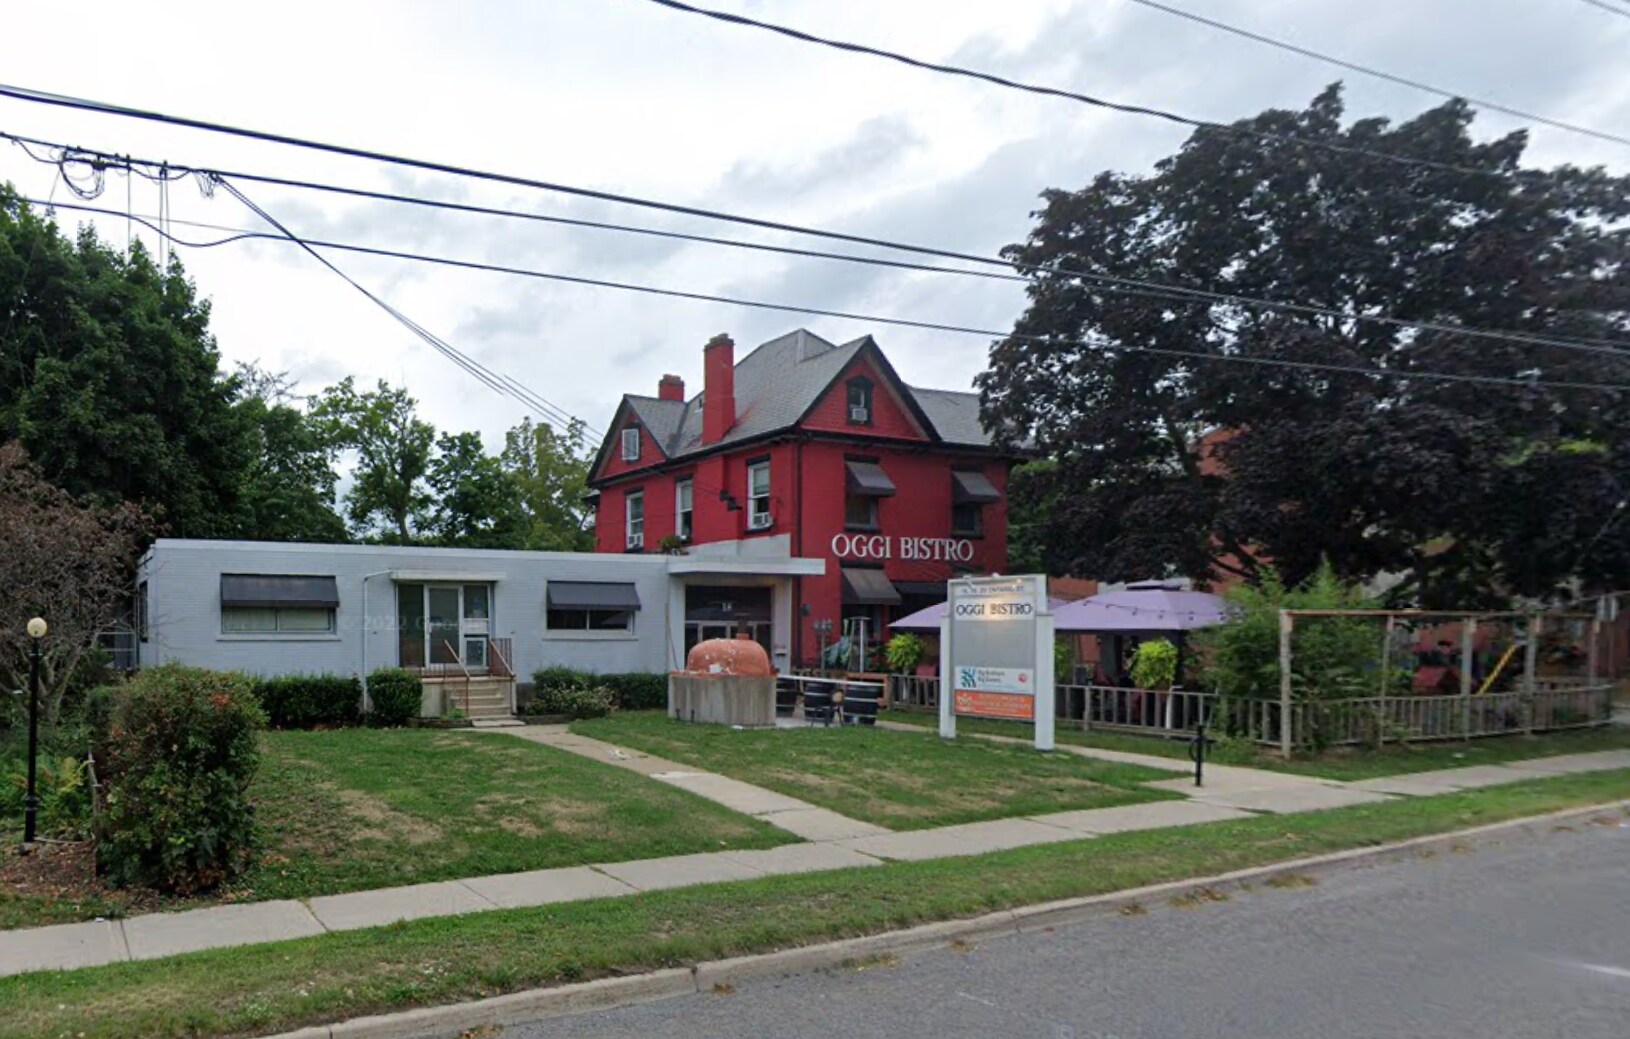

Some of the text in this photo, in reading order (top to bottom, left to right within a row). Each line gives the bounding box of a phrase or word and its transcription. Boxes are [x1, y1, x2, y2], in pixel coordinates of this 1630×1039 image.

[831, 533, 974, 561] OGGI BISTRO
[956, 603, 1032, 615] OGGI BISTRO
